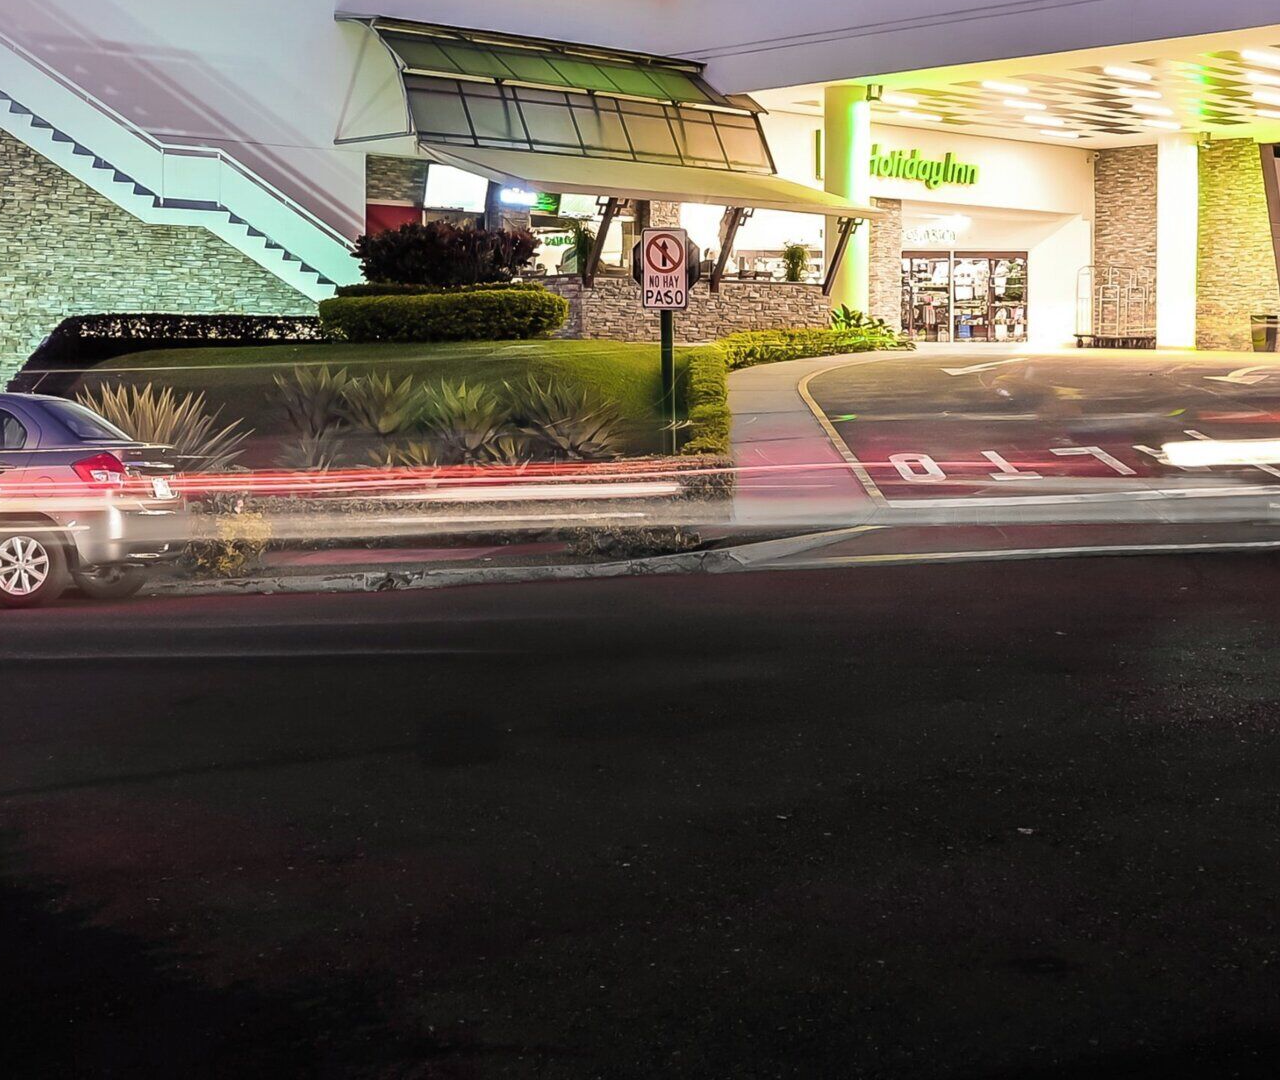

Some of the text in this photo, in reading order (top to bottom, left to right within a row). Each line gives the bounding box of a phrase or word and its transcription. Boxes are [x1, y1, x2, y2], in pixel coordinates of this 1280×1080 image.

[942, 151, 979, 186] Inn
[649, 275, 680, 288] NO HAY
[645, 290, 684, 305] PASO
